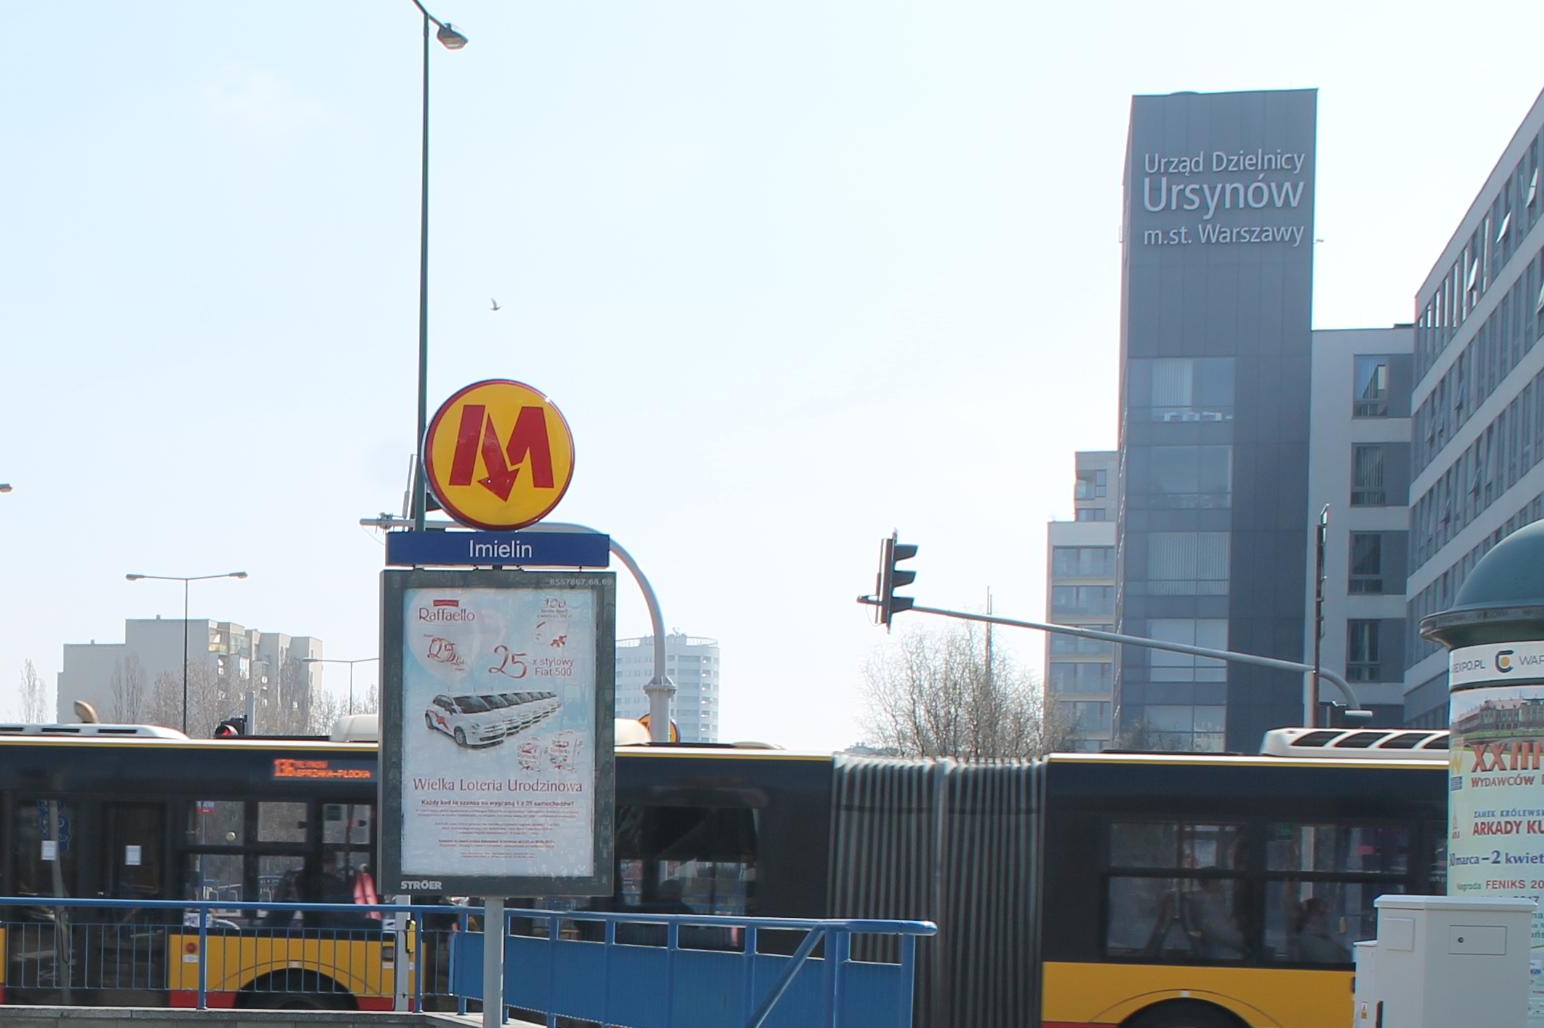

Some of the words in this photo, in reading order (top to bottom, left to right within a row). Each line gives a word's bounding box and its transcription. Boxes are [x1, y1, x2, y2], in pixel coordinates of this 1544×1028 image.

[1144, 151, 1204, 176] Urząd
[1211, 149, 1305, 174] Dzielnicy
[1143, 173, 1305, 220] Ursynów
[1144, 226, 1192, 245] m.st.
[1198, 223, 1305, 247] Warszawy
[469, 539, 533, 558] Imielin
[419, 607, 475, 623] Raffaello
[488, 645, 527, 679] 25
[540, 657, 574, 667] stylowy
[535, 667, 553, 676] Fiat
[554, 666, 572, 676] 500
[1472, 741, 1543, 773] XXIII
[413, 777, 455, 791] Wielka
[460, 777, 503, 792] Loteria
[508, 777, 583, 793] Urodzinowa
[1471, 774, 1535, 788] WYDAWCÓW
[1473, 820, 1522, 836] ARKADY
[1490, 849, 1501, 864] 2
[400, 879, 443, 890] STRÖER
[1486, 879, 1526, 889] FENIKS
